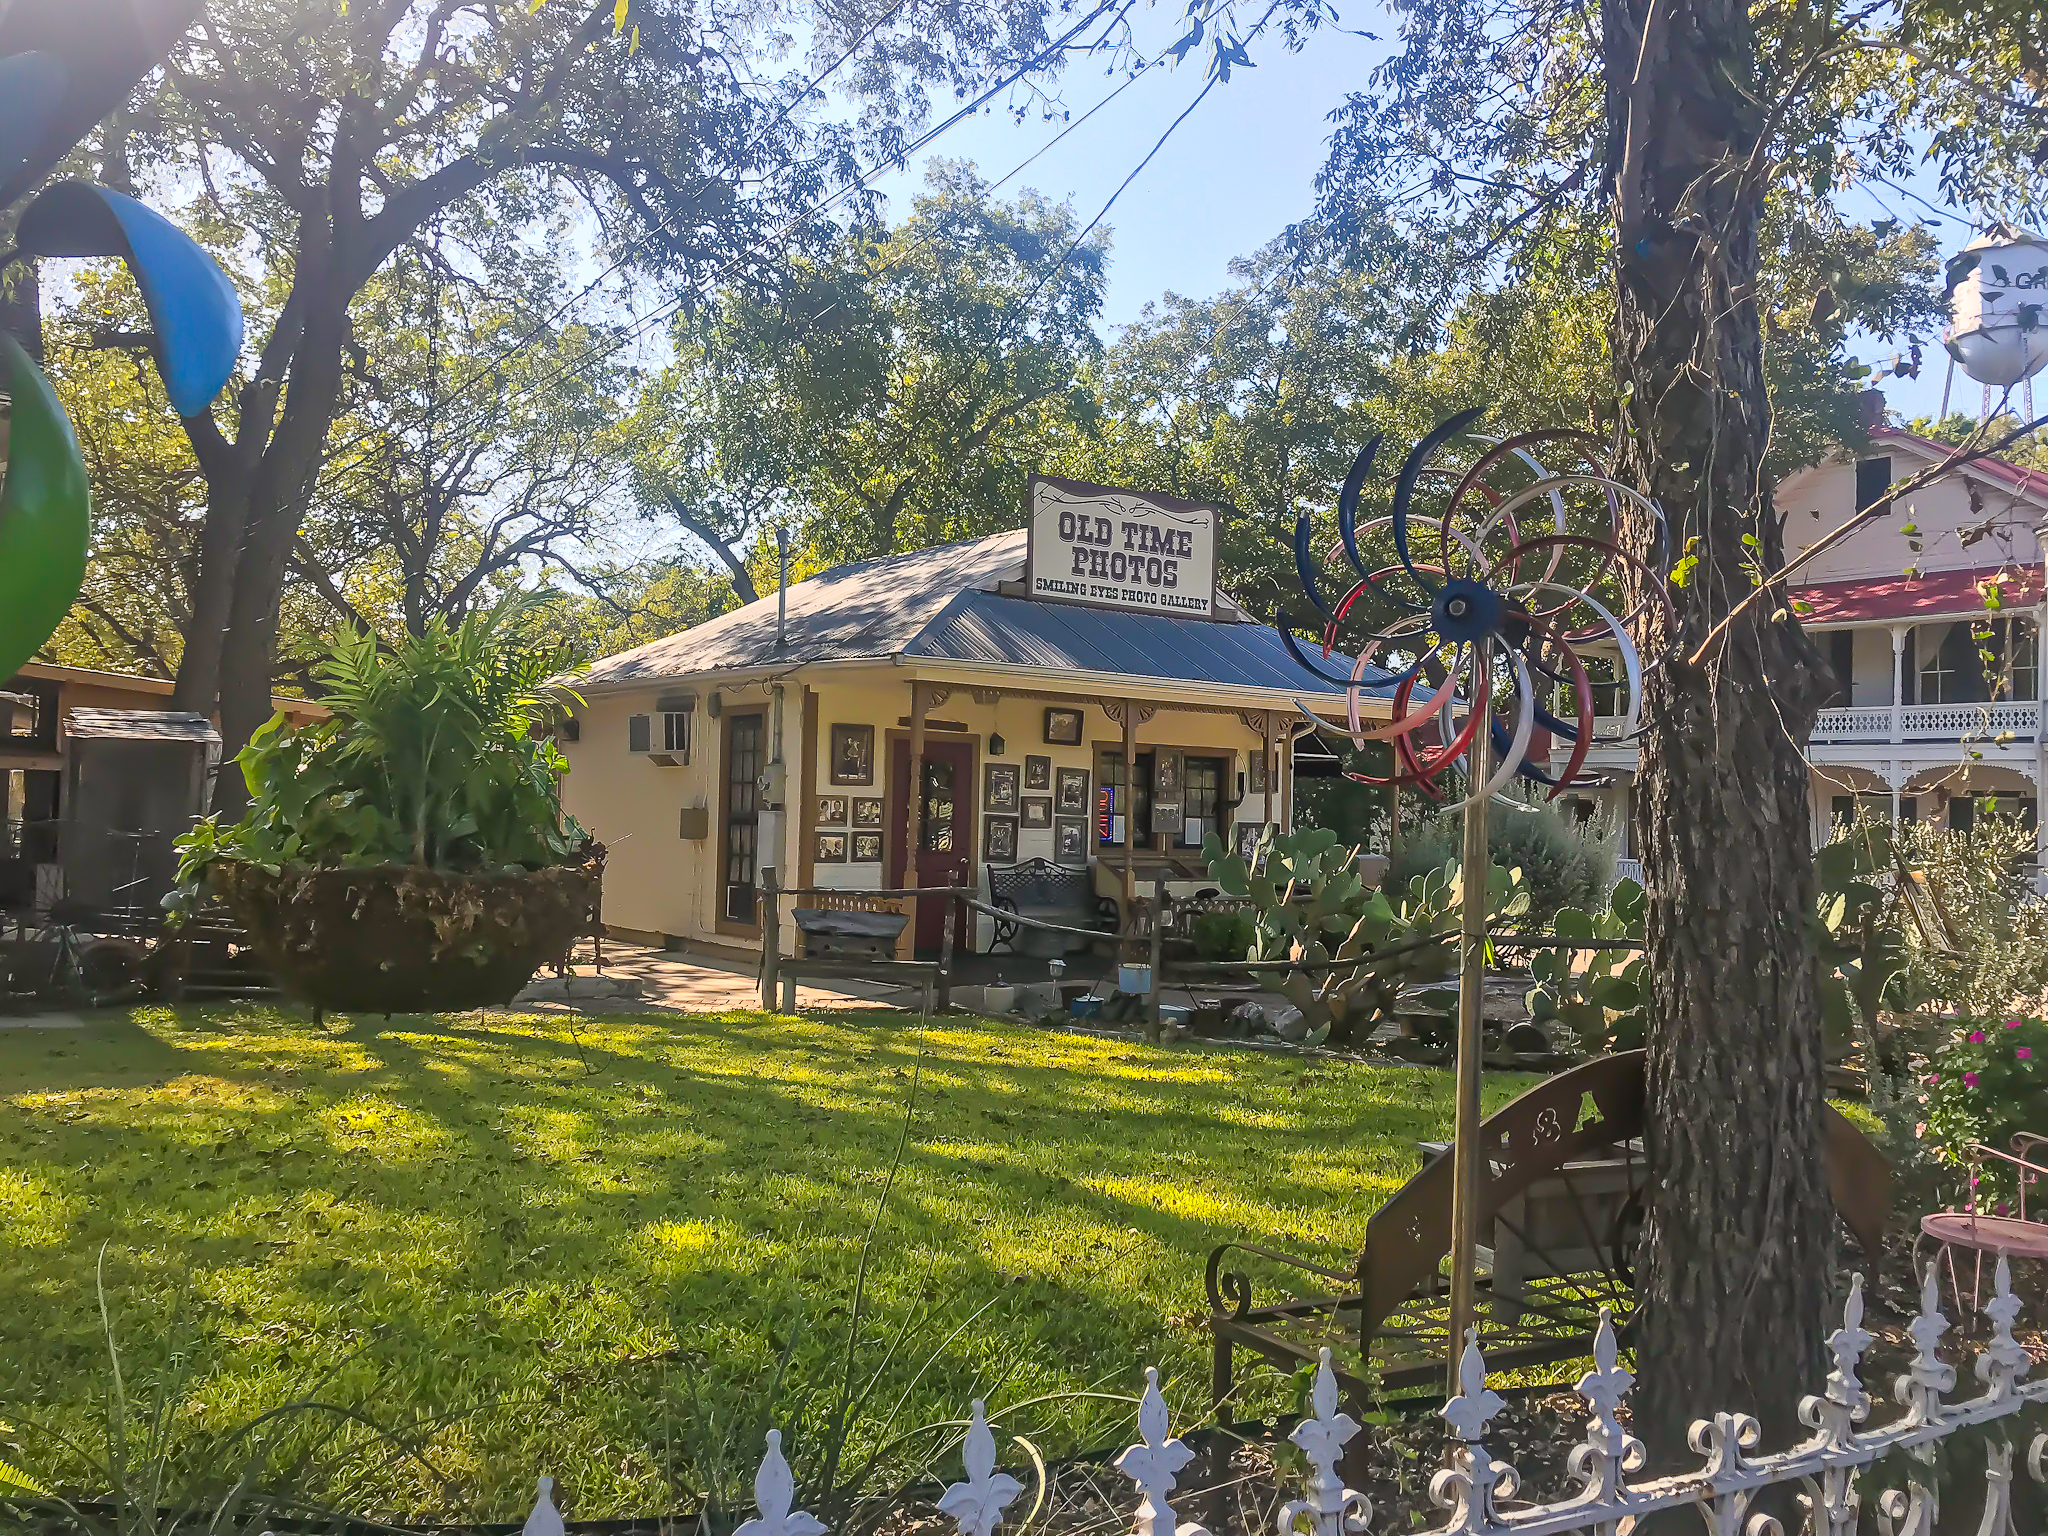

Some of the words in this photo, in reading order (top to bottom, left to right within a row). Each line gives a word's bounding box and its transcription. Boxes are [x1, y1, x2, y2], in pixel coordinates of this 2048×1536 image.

[1058, 511, 1113, 547] OLD
[1121, 521, 1192, 560] TIME
[1071, 546, 1178, 589] PHOTOS
[1036, 577, 1087, 596] SMILING
[1090, 584, 1119, 599] EYES
[1121, 588, 1157, 604] PHOTO
[1160, 594, 1209, 611] GALLERY
